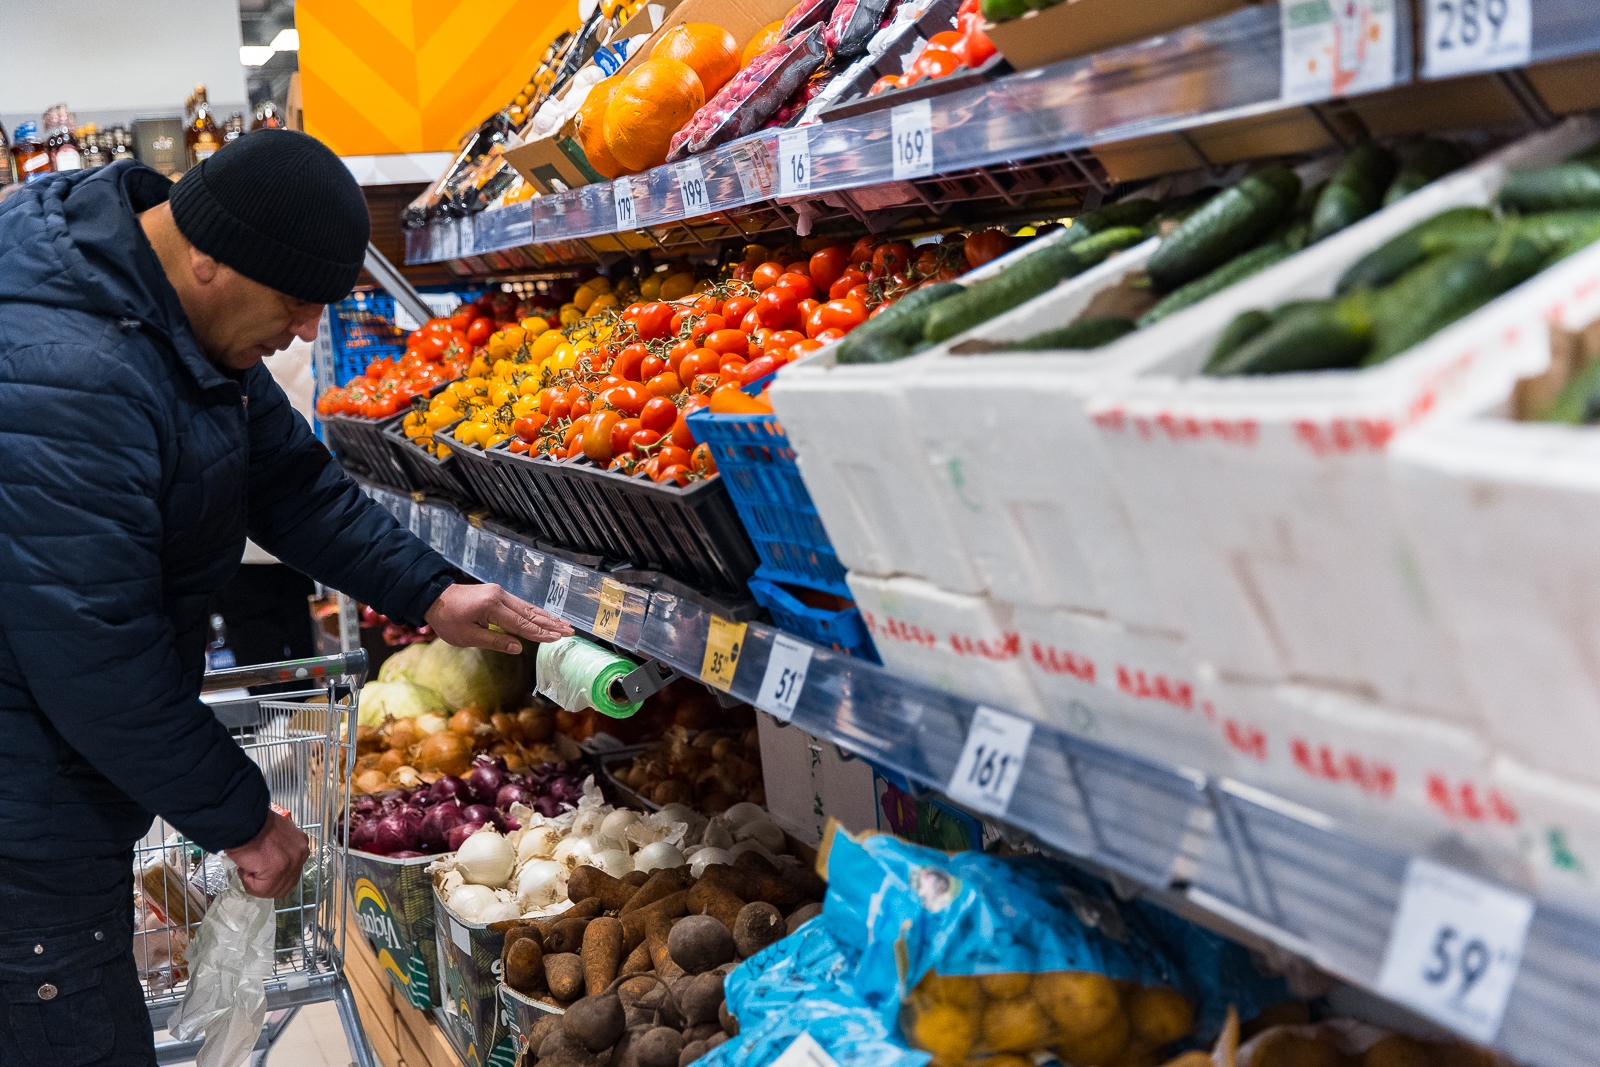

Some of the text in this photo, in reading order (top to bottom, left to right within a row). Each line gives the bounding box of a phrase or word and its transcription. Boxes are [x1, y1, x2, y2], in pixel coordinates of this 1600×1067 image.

[1437, 0, 1508, 50] 289
[898, 130, 924, 165] 169
[791, 154, 804, 183] 16
[683, 178, 702, 206] 199
[618, 197, 631, 220] 179
[547, 580, 565, 606] 249
[600, 609, 611, 627] 29
[711, 652, 723, 674] 35
[775, 669, 797, 703] 51
[967, 744, 1010, 792] 161
[1421, 924, 1491, 998] 59
